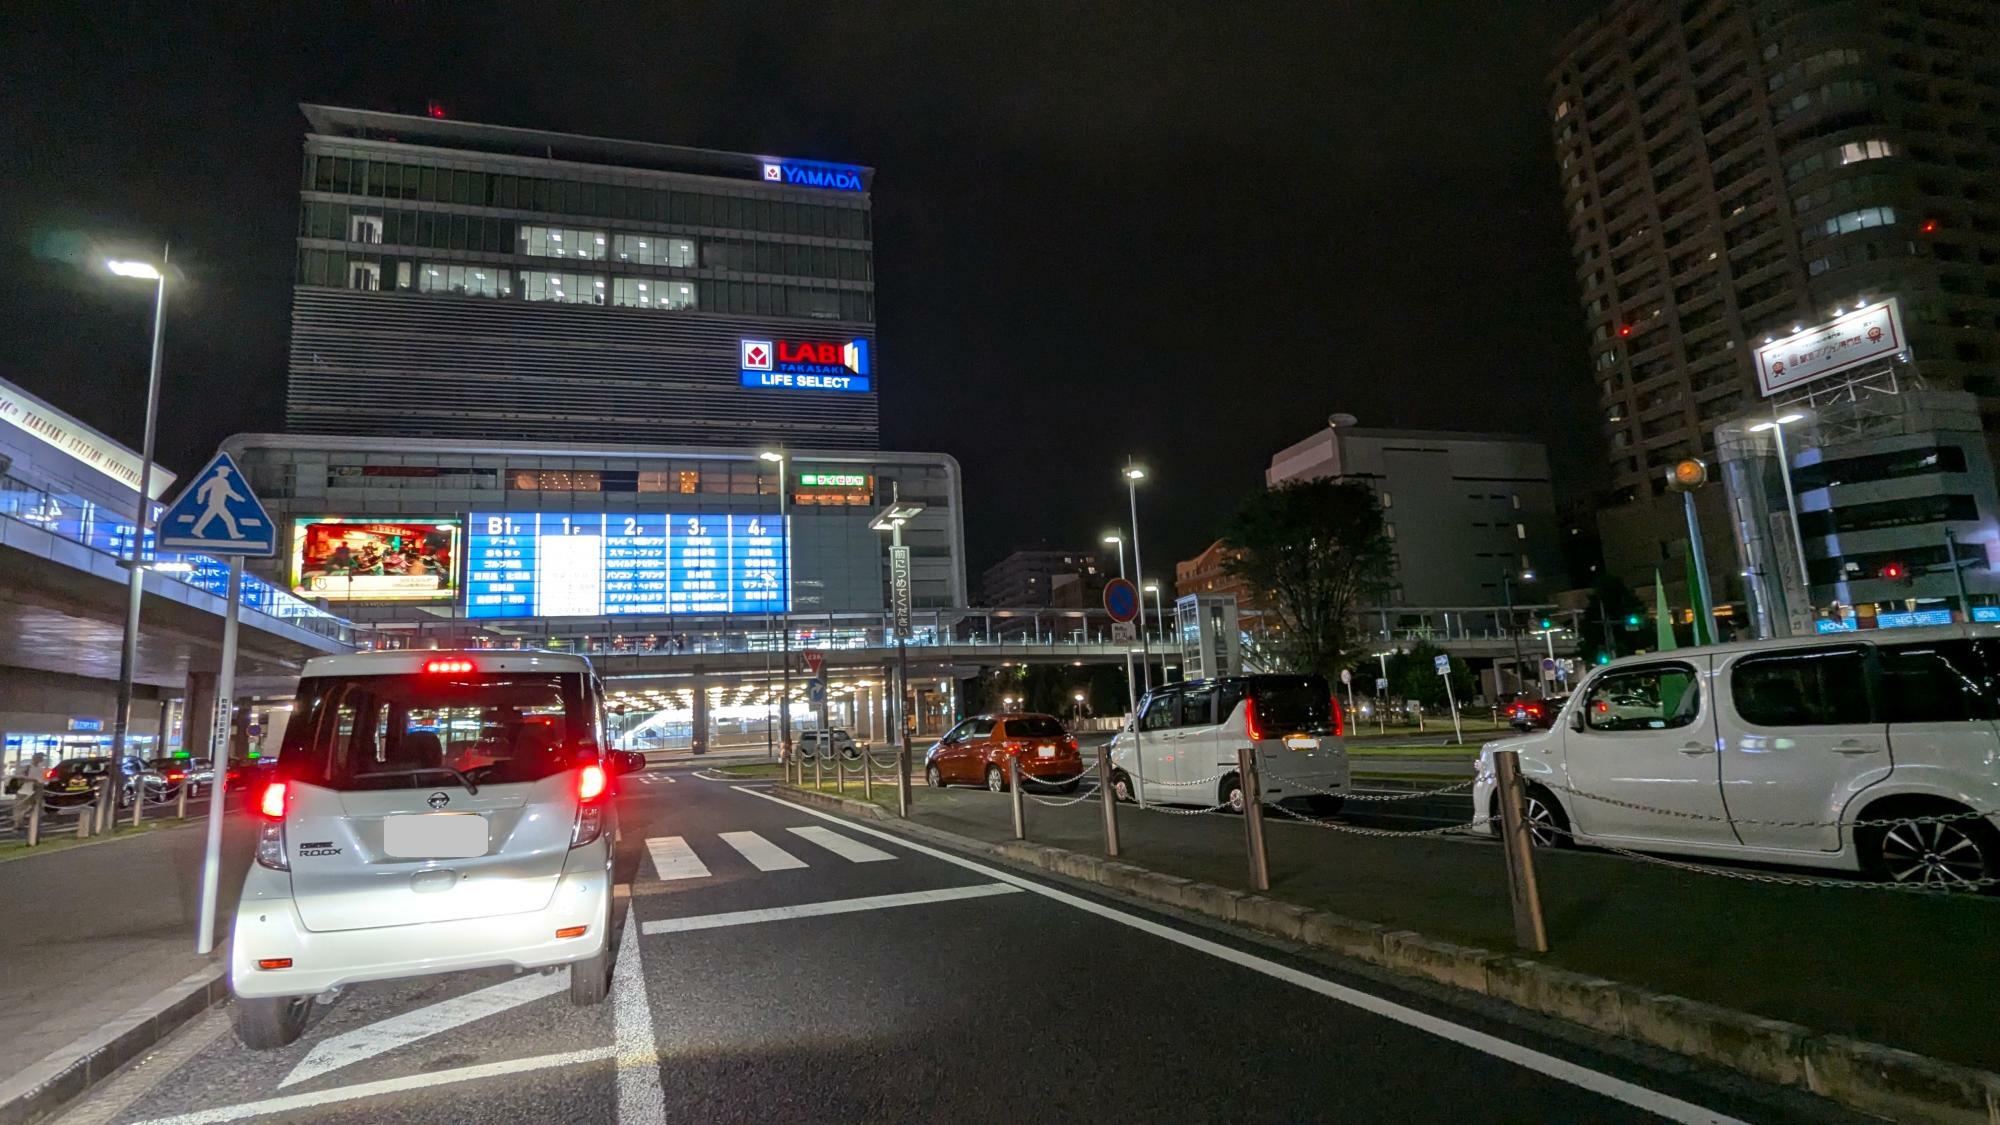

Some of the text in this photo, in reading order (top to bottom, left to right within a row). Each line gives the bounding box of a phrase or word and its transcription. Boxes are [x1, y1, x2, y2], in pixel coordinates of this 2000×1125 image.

[783, 165, 863, 193] YAMADA
[781, 364, 844, 374] TAKASAKI
[761, 373, 850, 388] LIFE SELECT
[818, 476, 863, 485] サイゼリヤ
[562, 517, 581, 535] 1F
[624, 517, 644, 535] 2F
[687, 518, 707, 535] 3F
[748, 518, 767, 535] 4F
[609, 549, 663, 557] スマートフォン
[894, 549, 909, 637] 前につめてください
[1819, 621, 1850, 632] NOVA
[299, 848, 343, 857] ROOX
